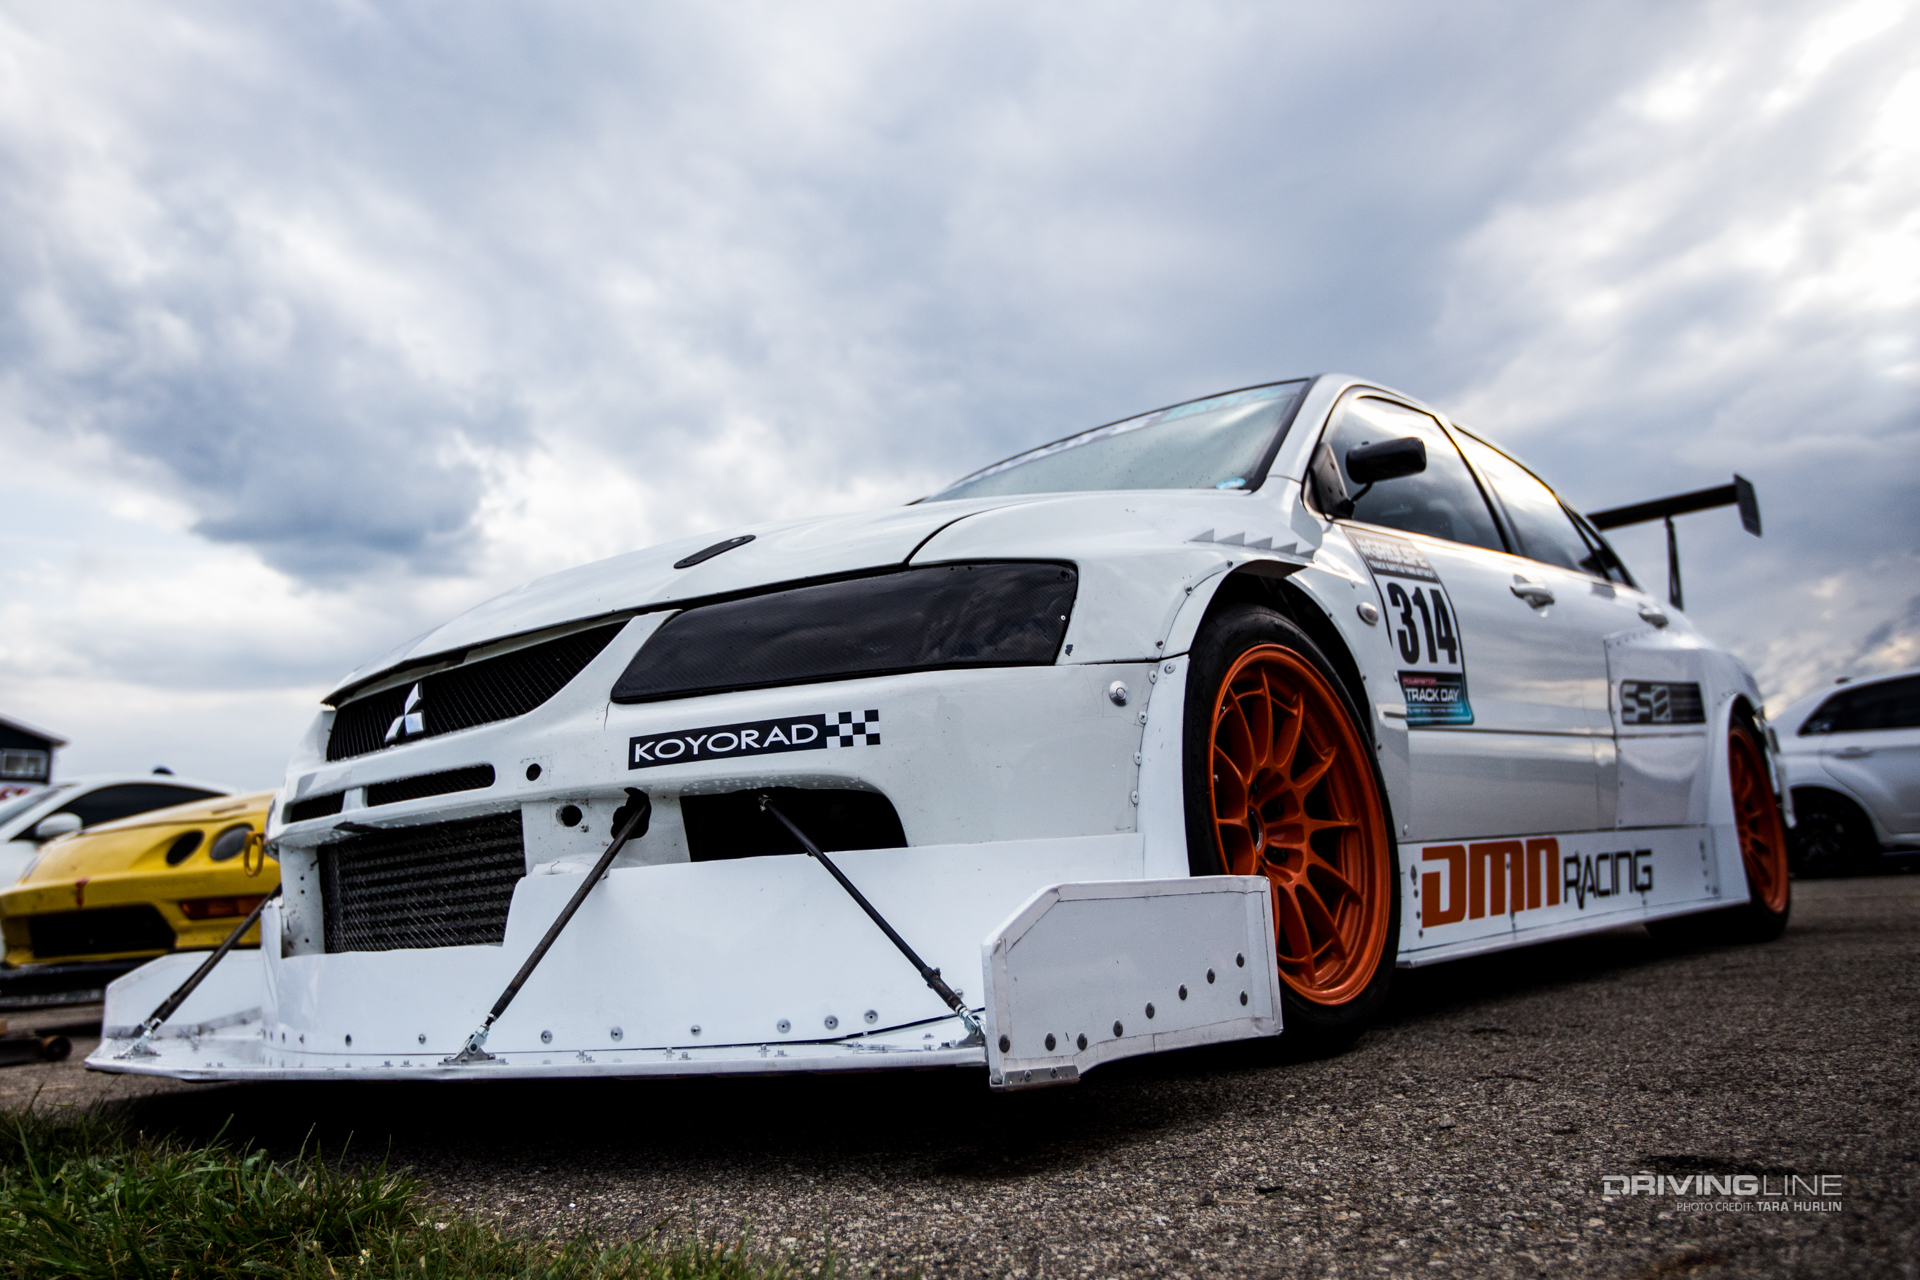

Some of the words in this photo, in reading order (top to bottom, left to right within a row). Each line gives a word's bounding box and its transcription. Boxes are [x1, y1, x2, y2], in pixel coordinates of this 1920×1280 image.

[1387, 582, 1457, 664] 314
[1405, 688, 1440, 702] TRACK
[1440, 688, 1460, 702] DAY
[634, 723, 819, 763] KOYORAD
[1563, 848, 1653, 910] RACING
